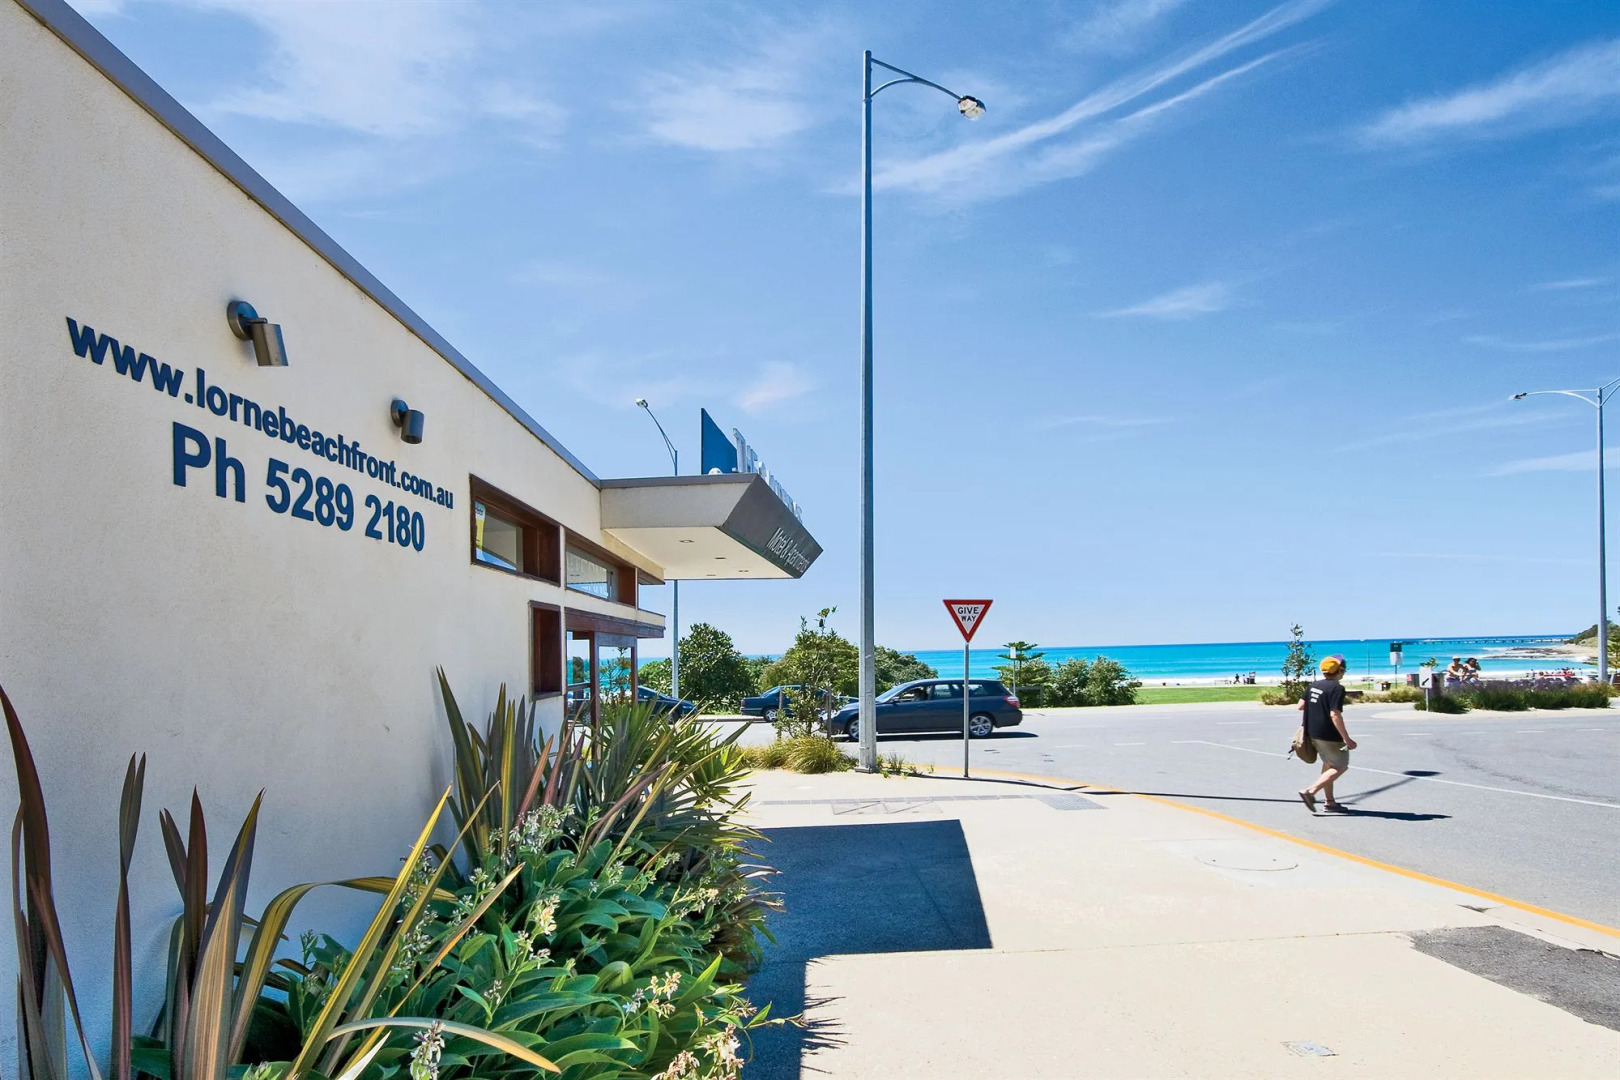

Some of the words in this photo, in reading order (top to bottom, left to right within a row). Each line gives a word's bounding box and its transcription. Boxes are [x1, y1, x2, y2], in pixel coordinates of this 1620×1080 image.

[66, 317, 454, 510] www.lornebeachfront.com.au
[172, 421, 246, 503] Ph
[265, 457, 355, 532] 5289
[364, 494, 425, 552] 2180
[957, 606, 979, 615] GIVE
